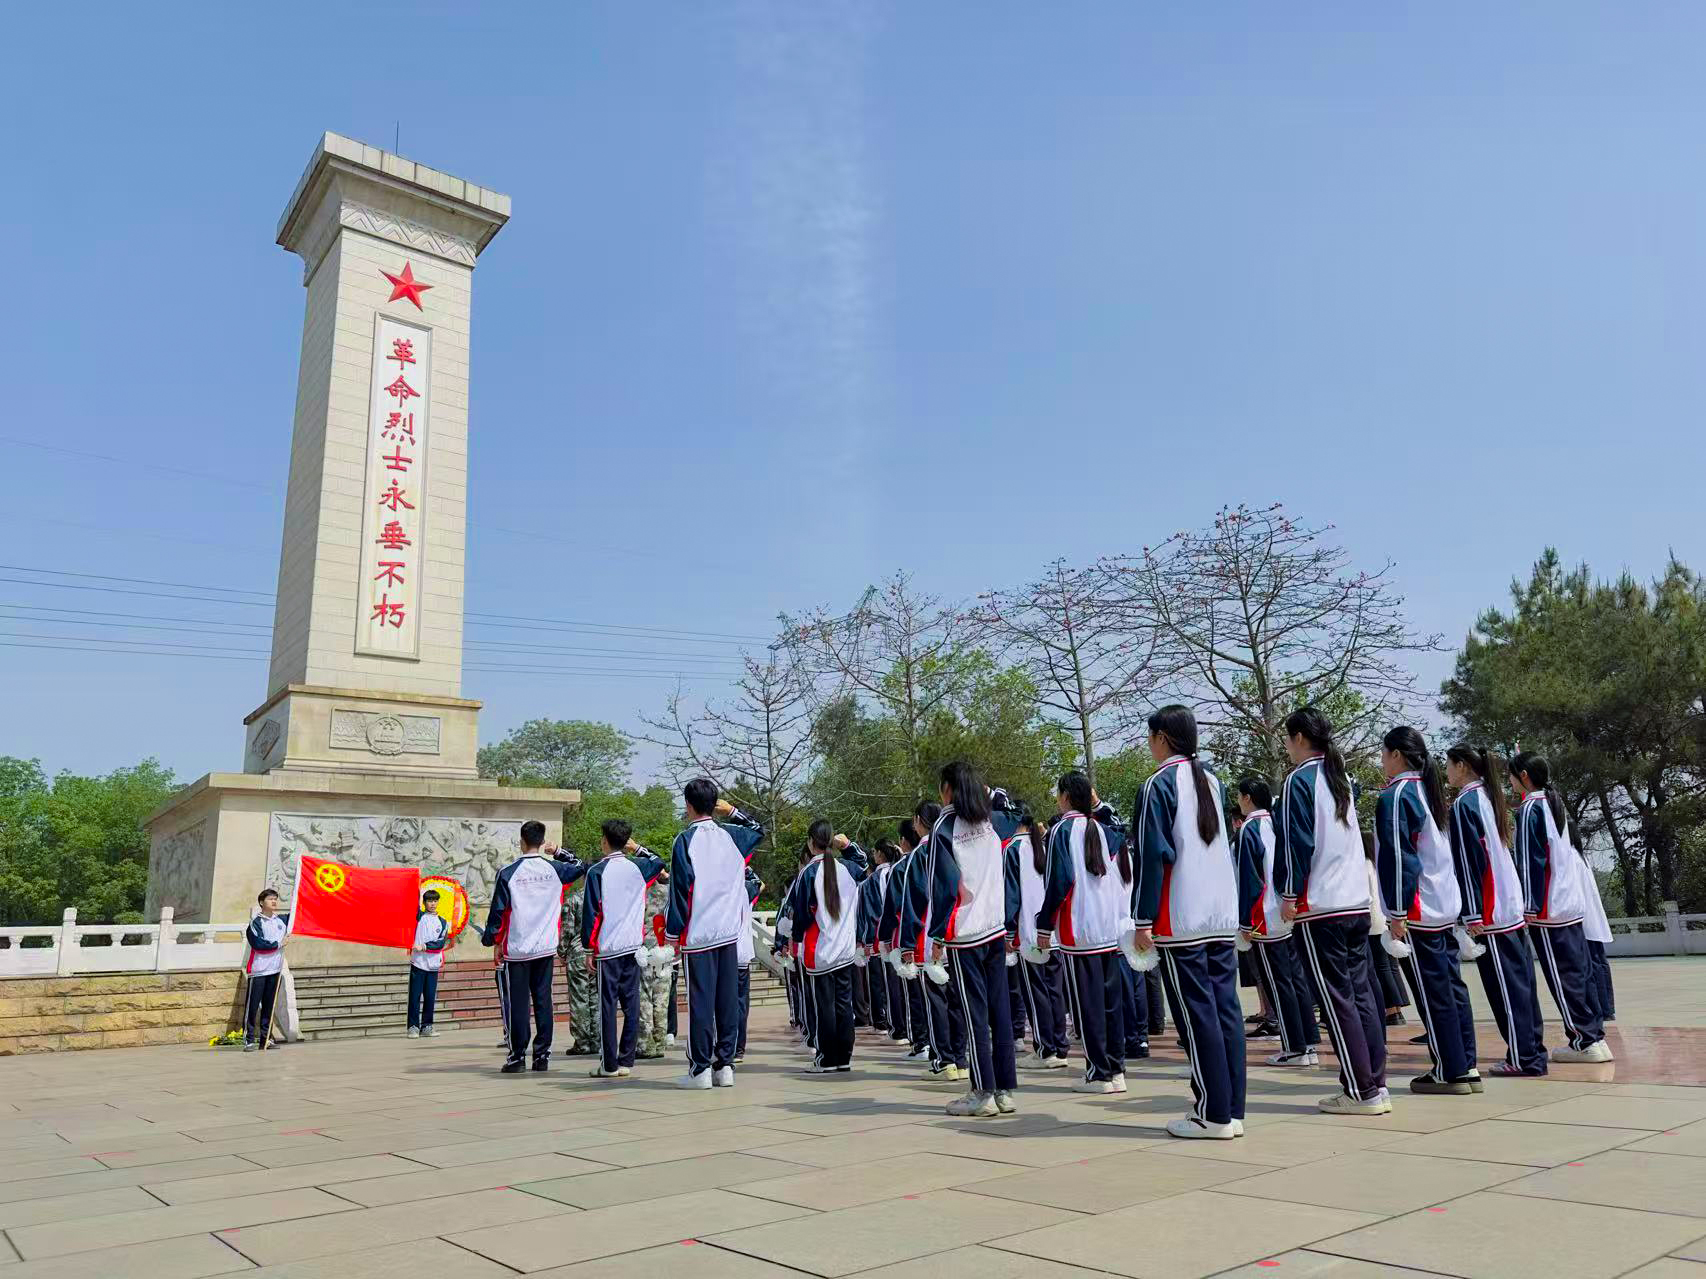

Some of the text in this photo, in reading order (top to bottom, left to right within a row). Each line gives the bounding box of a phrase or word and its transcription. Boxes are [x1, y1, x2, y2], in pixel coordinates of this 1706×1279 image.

[370, 338, 420, 629] 革命烈士永垂不朽
